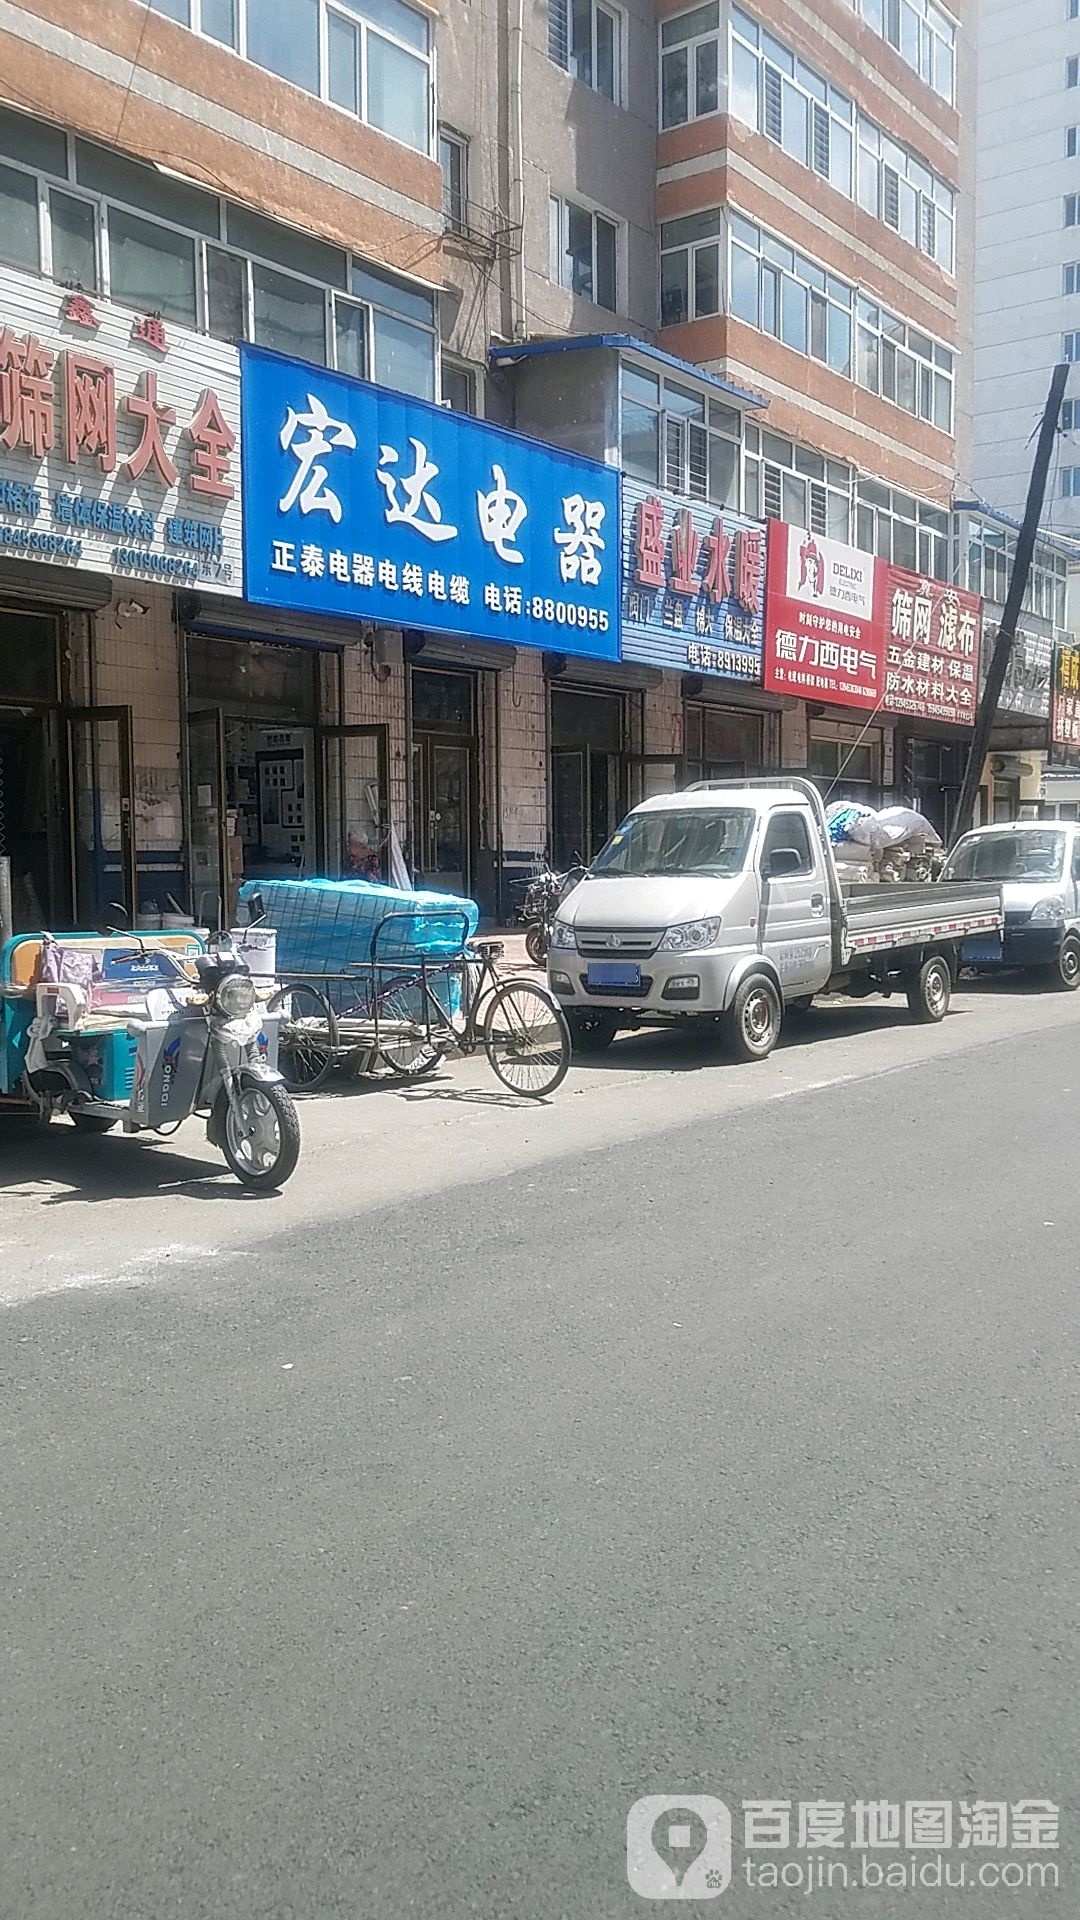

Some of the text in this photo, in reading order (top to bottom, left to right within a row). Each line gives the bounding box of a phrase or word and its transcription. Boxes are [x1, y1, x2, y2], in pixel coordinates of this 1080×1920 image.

[66, 294, 169, 353] 鑫通
[0, 325, 235, 499] 筛网大全
[278, 392, 606, 586] 宏达电器
[56, 493, 154, 539] 墙体保温材料
[166, 517, 223, 555] 建筑网片
[272, 540, 470, 605] 正泰电器电线电缆
[635, 495, 761, 615] 盛业水暖
[833, 562, 863, 583] DELIXI
[725, 613, 758, 644] 保温大全
[892, 588, 977, 657] 筛网 滤布
[775, 630, 877, 680] 德力西电气
[886, 645, 973, 682] 五金建材 保温
[887, 671, 972, 706] 防水材料大全
